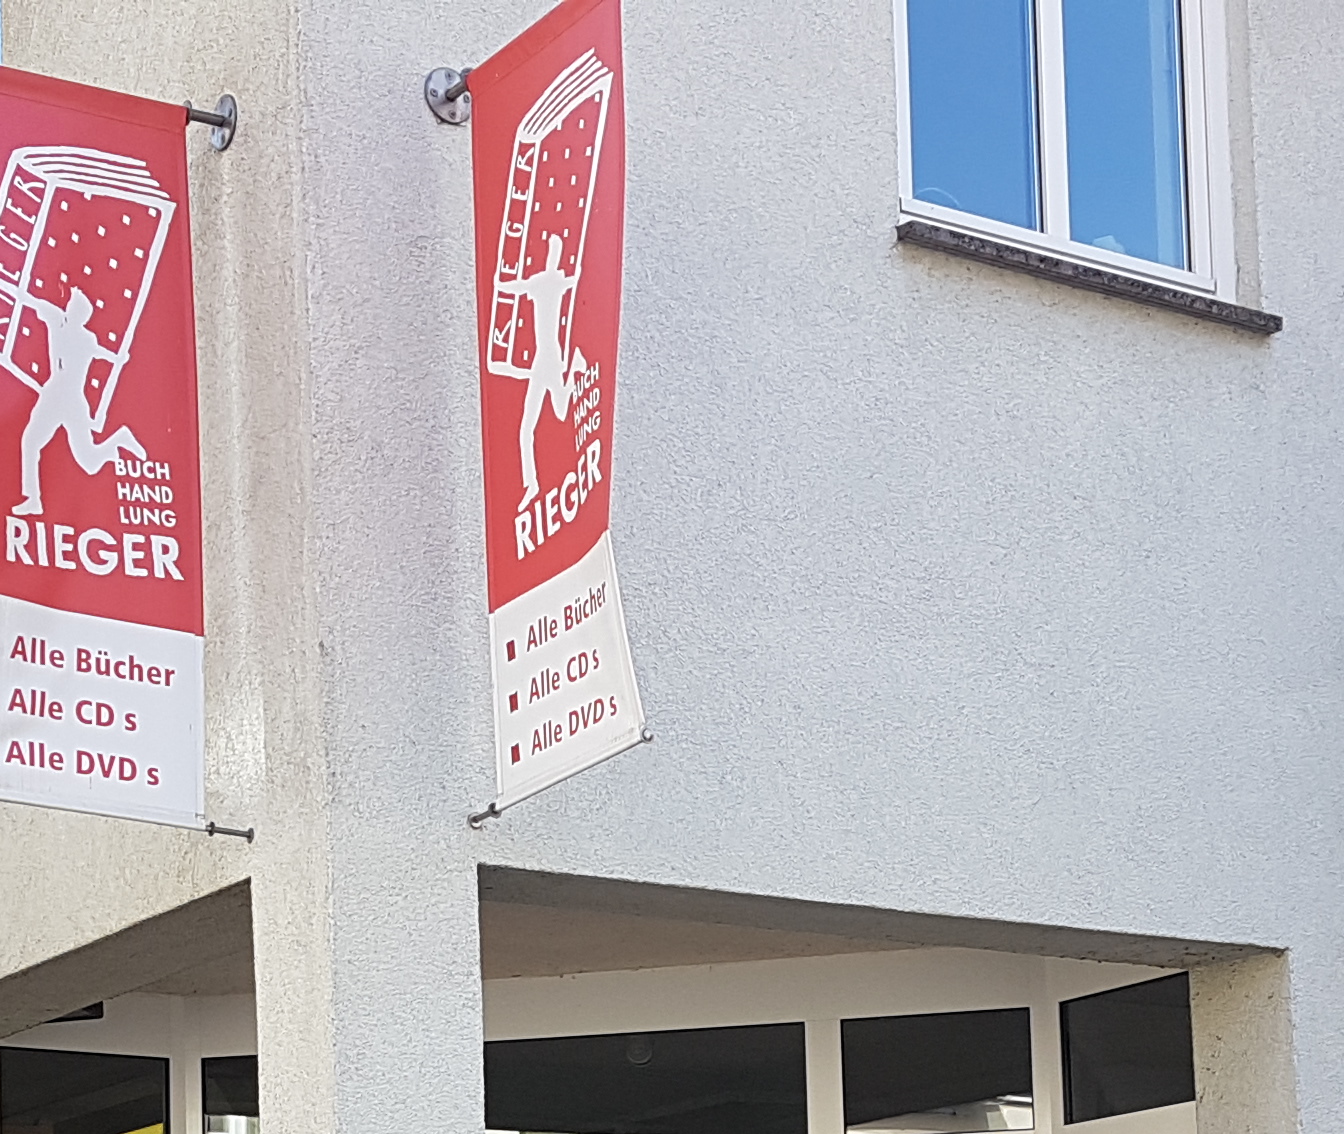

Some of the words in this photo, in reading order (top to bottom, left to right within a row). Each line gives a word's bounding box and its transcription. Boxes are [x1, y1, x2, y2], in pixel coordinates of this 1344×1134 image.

[572, 363, 599, 404] BUCH
[573, 388, 600, 428] HAND
[575, 412, 601, 452] LUNG
[114, 458, 170, 481] BUCH
[117, 482, 173, 504] HAND
[514, 439, 602, 560] RIEGER
[119, 506, 176, 528] LUNG
[5, 515, 184, 581] RIEGER
[526, 616, 557, 653] Alle
[563, 580, 607, 632] Bücher
[10, 635, 65, 669] Alle
[76, 647, 175, 687] Bücher
[8, 688, 64, 721] Alle
[528, 666, 560, 705] Alle
[5, 740, 64, 771] Alle
[531, 717, 563, 757] Alle
